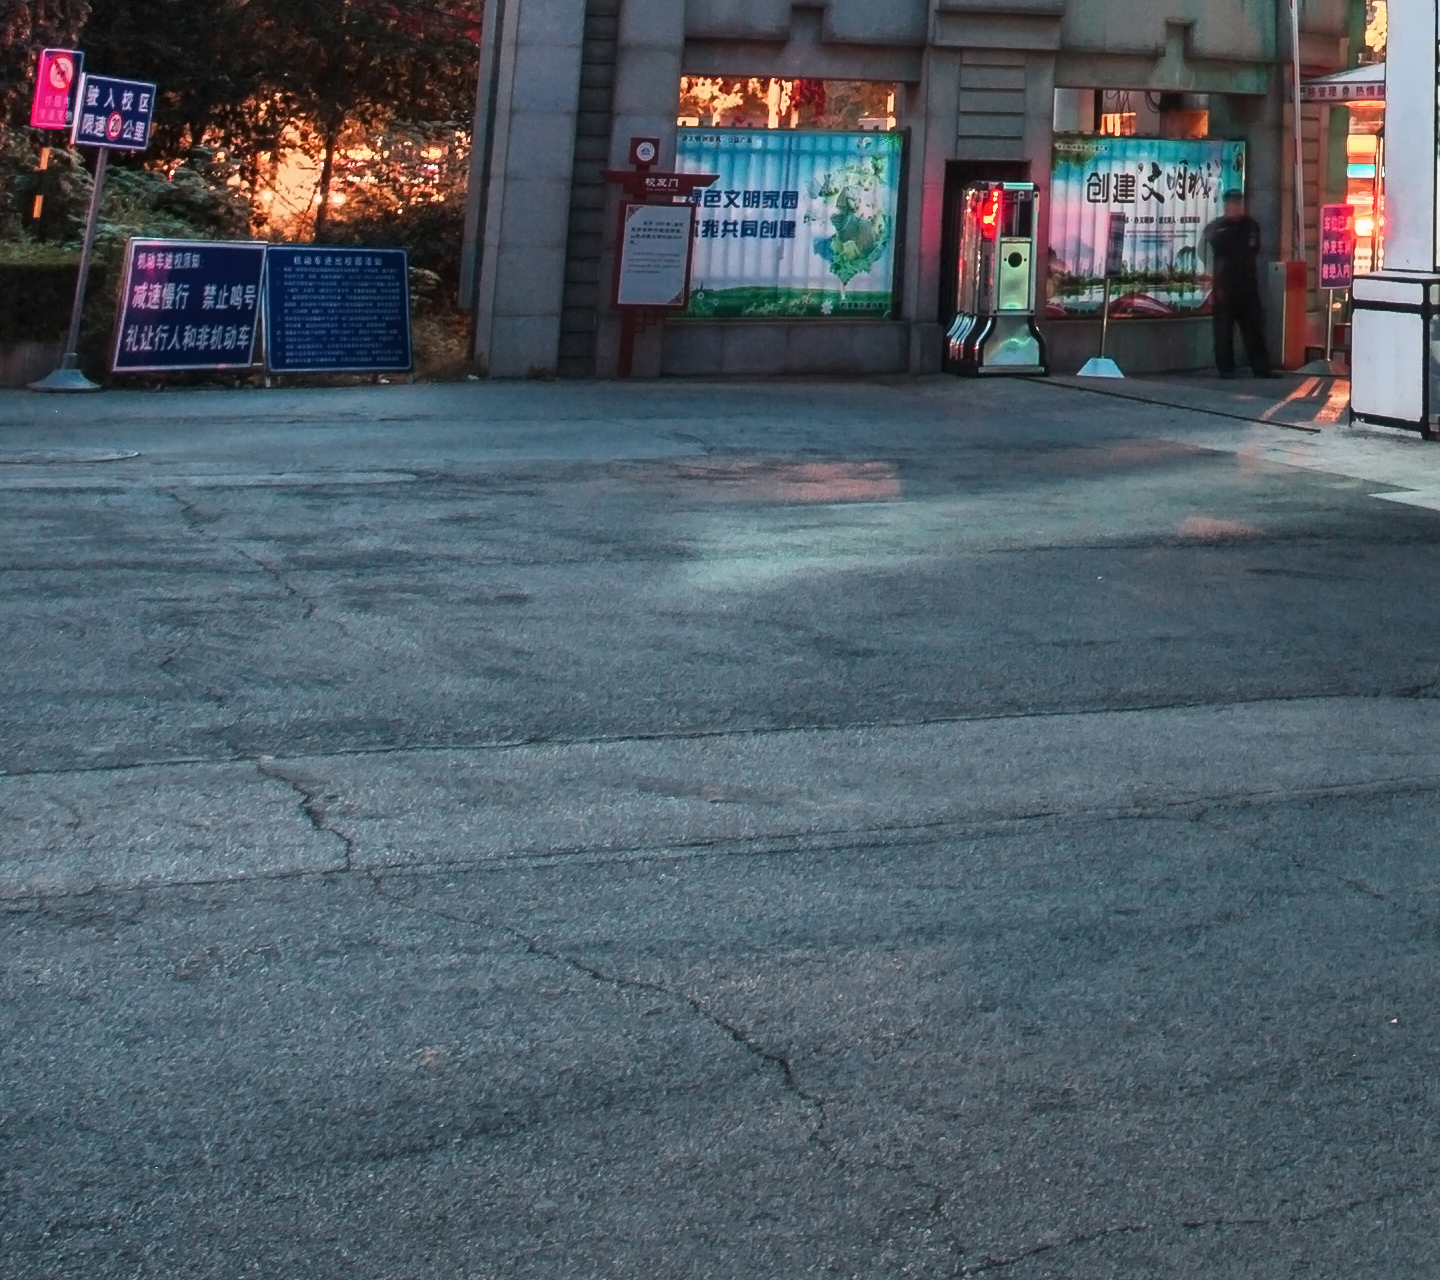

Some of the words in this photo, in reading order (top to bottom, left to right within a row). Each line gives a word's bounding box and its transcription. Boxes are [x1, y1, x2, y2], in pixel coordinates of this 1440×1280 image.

[86, 85, 150, 112] 驶入校区
[645, 177, 679, 188] 校友门
[132, 282, 190, 310] 减速慢行
[201, 283, 257, 310] 禁止鸣号
[125, 324, 251, 352] 礼让行人和非机动车
